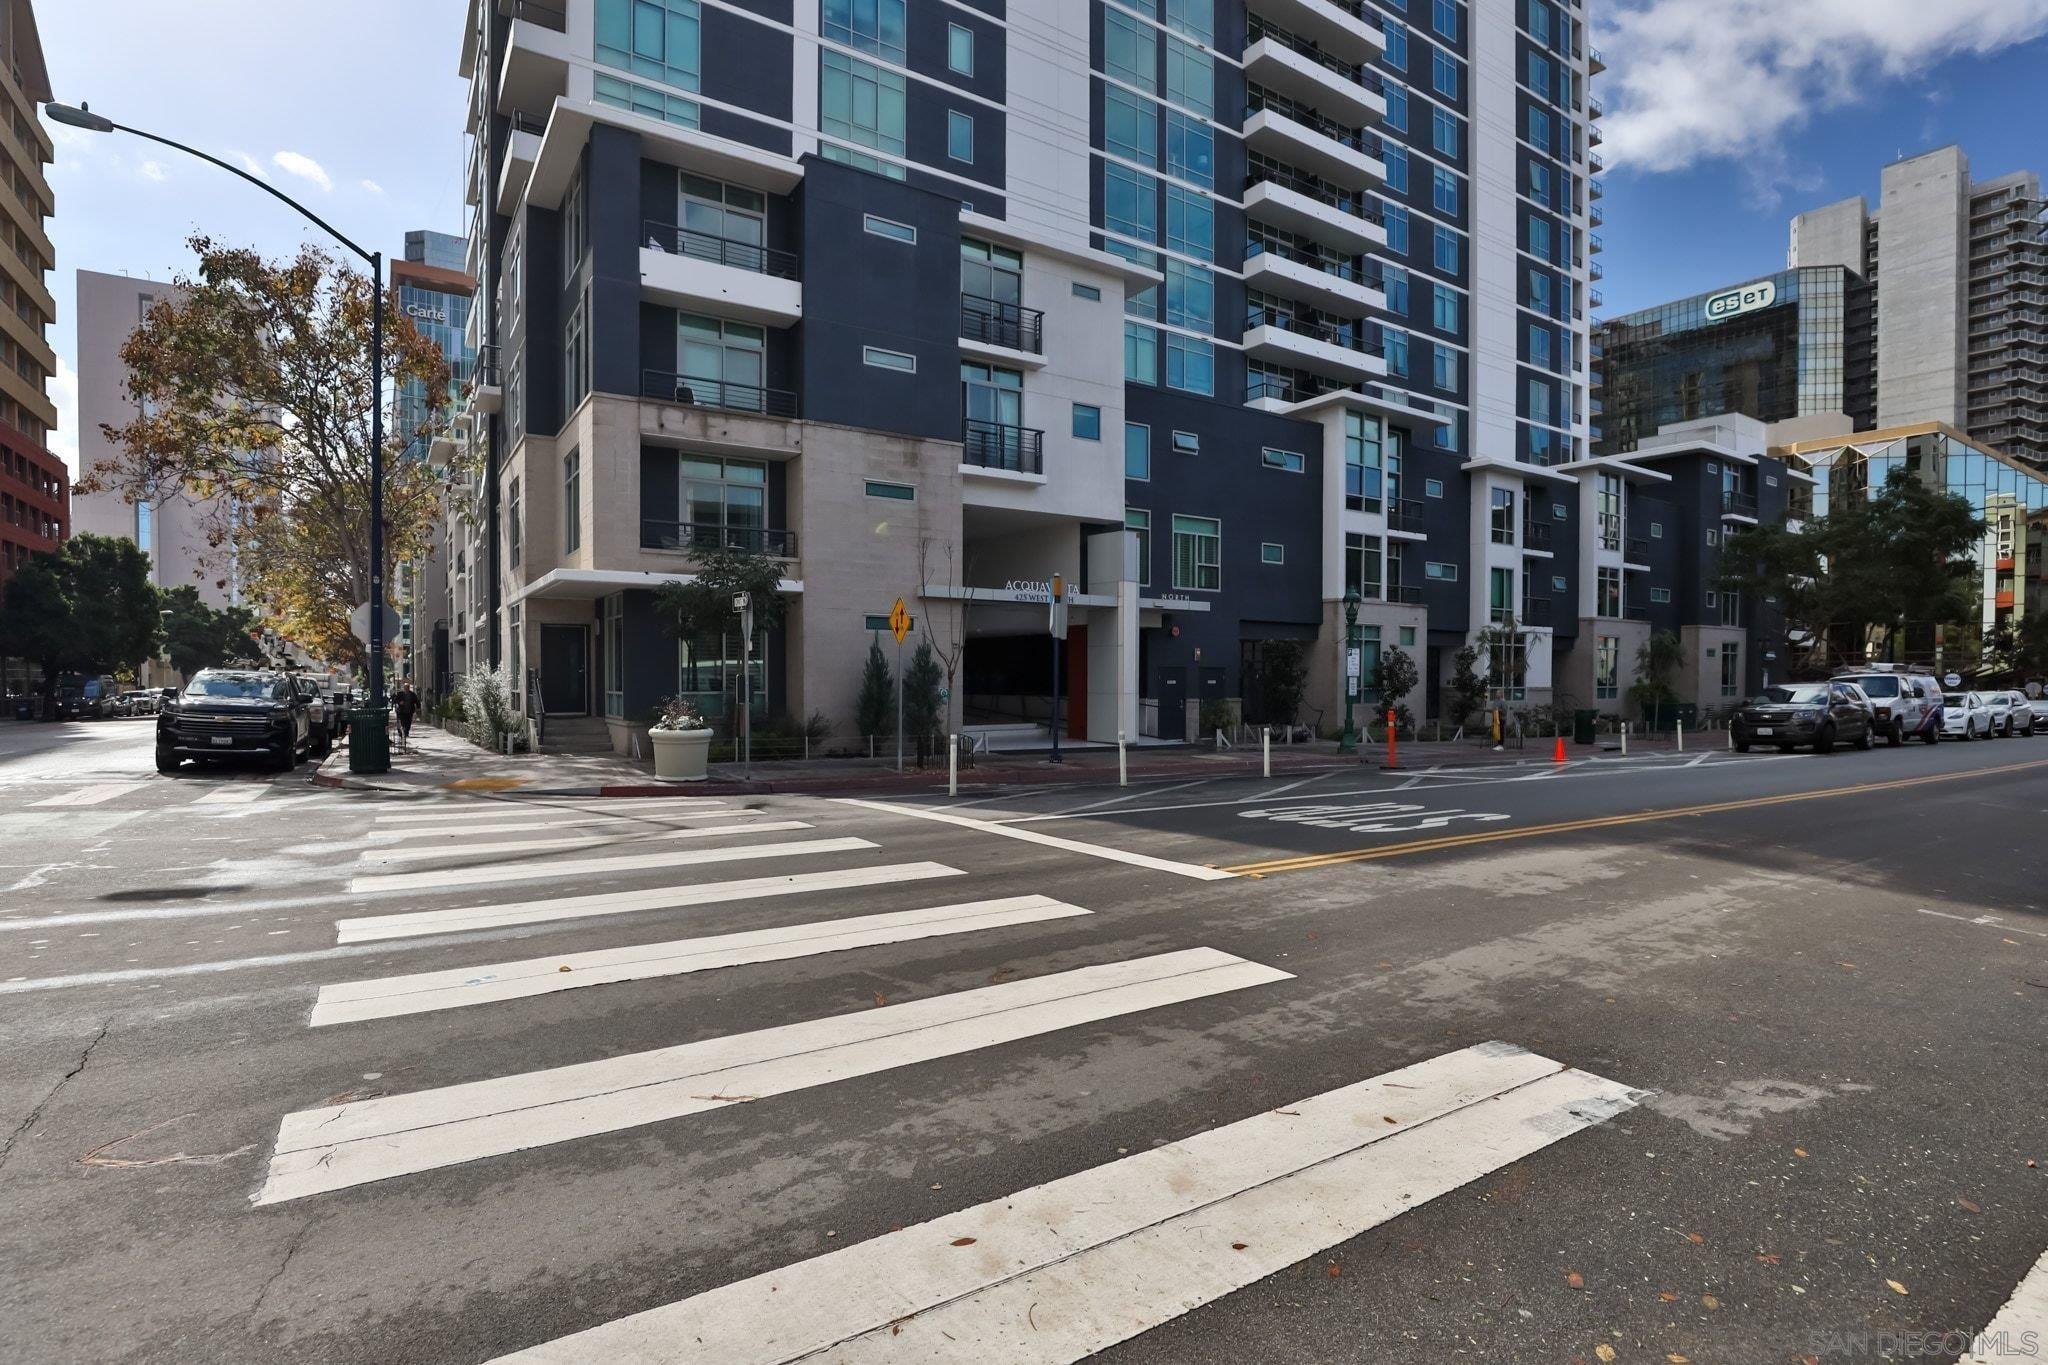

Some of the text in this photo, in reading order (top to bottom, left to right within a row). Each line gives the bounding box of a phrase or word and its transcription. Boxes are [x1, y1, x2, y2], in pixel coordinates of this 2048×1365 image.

[406, 304, 446, 320] Carté
[1005, 580, 1080, 594] ACQUAVTA
[1029, 594, 1048, 602] WEST
[1161, 593, 1190, 602] NORTH
[1237, 802, 1511, 833] STOP
